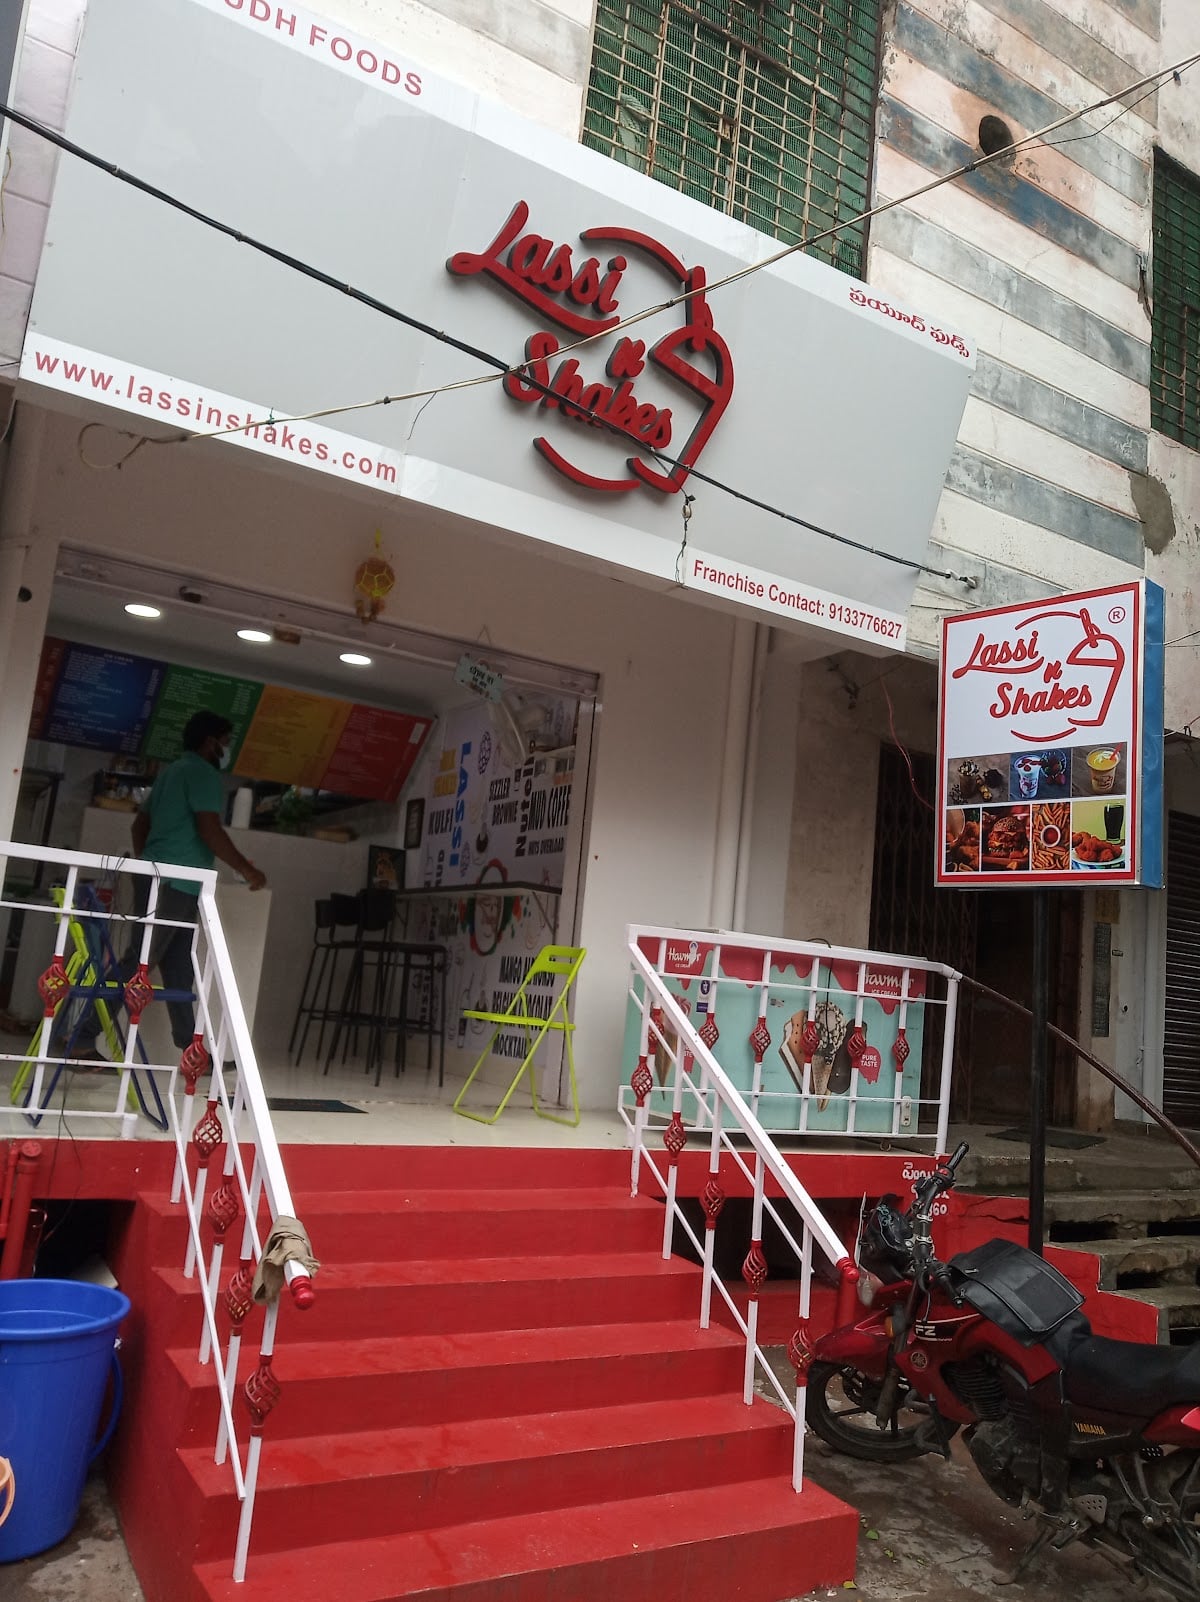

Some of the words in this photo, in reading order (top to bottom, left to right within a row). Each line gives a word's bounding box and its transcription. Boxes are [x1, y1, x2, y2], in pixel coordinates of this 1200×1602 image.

[309, 24, 422, 96] FOODS
[446, 199, 628, 338] Lassi
[34, 351, 398, 483] www.lassinshakes.com
[504, 331, 673, 450] Shakes
[693, 559, 764, 598] Franchise
[768, 583, 826, 617] Contact:
[828, 602, 902, 640] 9133776627
[952, 630, 1045, 680] Lassi
[989, 682, 1093, 719] Shakes
[428, 808, 454, 836] KULFI
[449, 741, 473, 867] LASSI
[860, 1060, 878, 1068] TASTE
[861, 1053, 878, 1061] PURE
[1074, 1422, 1107, 1436] YAMAHA
